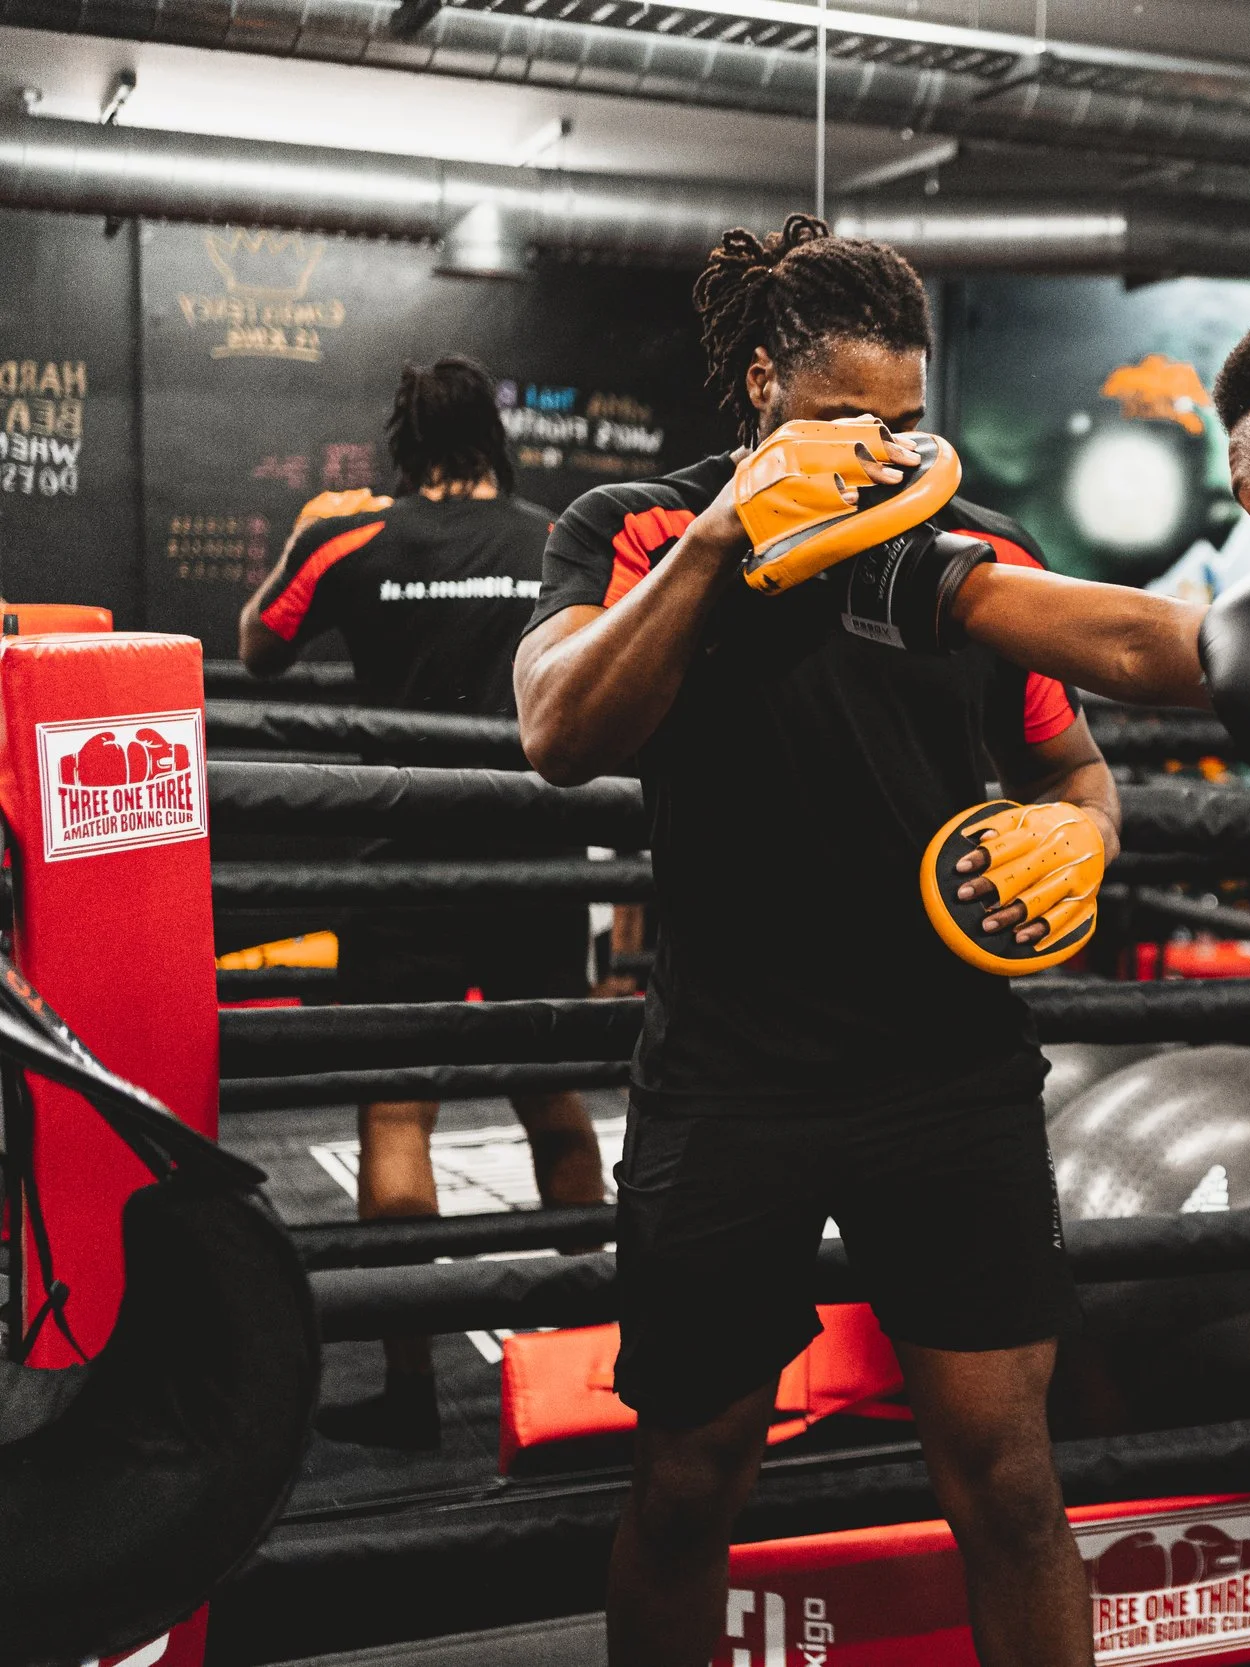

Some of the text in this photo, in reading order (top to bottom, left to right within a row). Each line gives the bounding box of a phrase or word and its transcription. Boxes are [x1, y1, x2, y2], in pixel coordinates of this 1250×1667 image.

[58, 771, 194, 829] THREE ONE THREE
[63, 810, 194, 842] AMATEUR BOXING CLUB
[796, 1597, 835, 1667] xigo
[1093, 1597, 1138, 1634] REE
[1145, 1591, 1188, 1622] ONE
[1094, 1625, 1150, 1652] ATEUR
[1154, 1616, 1218, 1644] BOXING
